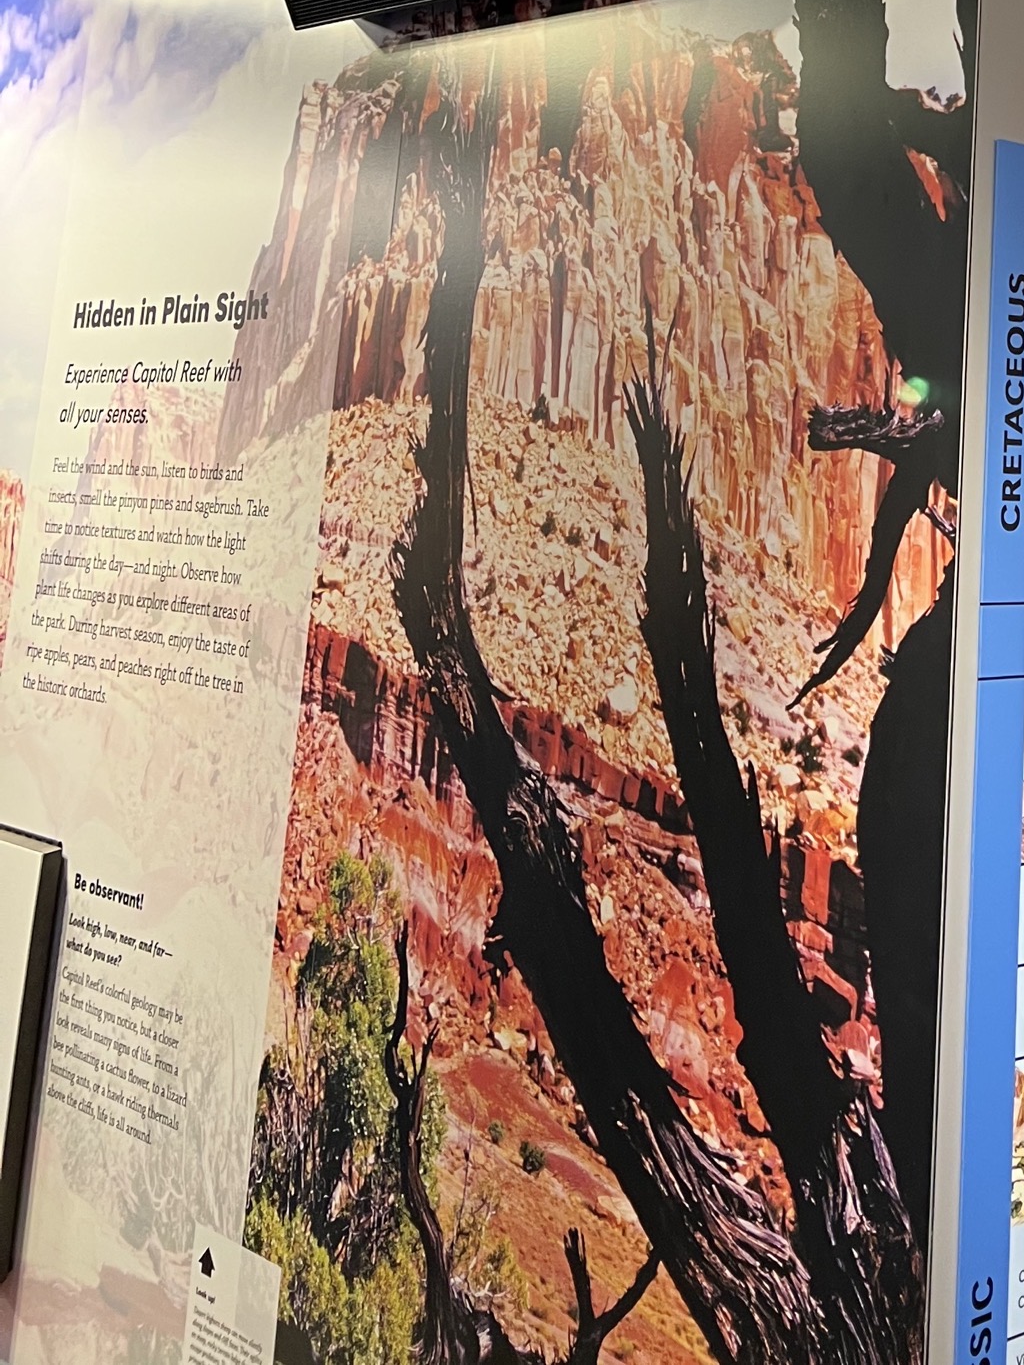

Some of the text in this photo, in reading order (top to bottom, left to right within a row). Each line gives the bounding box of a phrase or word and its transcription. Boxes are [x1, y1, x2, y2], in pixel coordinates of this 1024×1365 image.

[73, 290, 269, 329] Hidden in Plain Sight
[65, 358, 242, 390] Experience Capitol Reef with
[59, 401, 149, 430] all your senses.
[44, 519, 246, 555] time to notice textures and watch how the light
[40, 548, 62, 565] shifts
[64, 550, 91, 573] during
[93, 553, 107, 569] the
[152, 560, 177, 582] night.
[181, 562, 219, 582] Observe
[221, 565, 242, 585] how
[35, 579, 252, 621] plant life changes as you explore different areas of
[31, 610, 251, 657] the park. During harvest season, enjoy the taste of
[23, 672, 107, 703] the historic orchards.
[74, 873, 144, 910] Be observant!
[69, 913, 85, 929] Look
[139, 940, 153, 953] and
[66, 937, 122, 967] what do you see?
